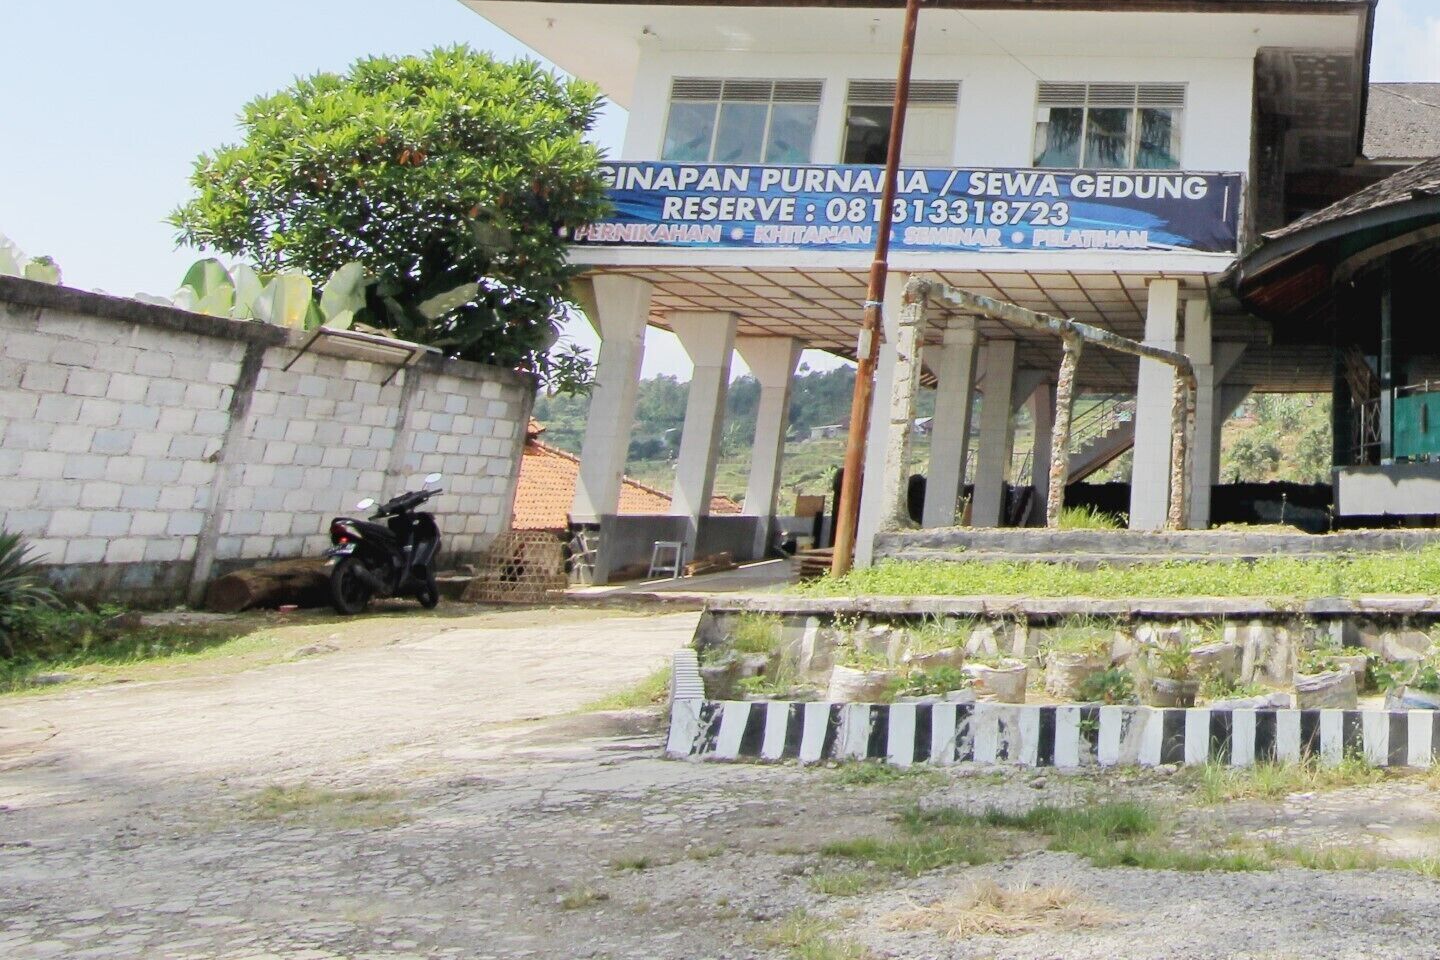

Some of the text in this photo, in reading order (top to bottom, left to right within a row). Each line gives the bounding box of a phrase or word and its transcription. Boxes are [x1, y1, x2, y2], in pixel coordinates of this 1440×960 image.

[968, 171, 1060, 197] SEWA
[1070, 174, 1208, 200] GEDUNG
[662, 196, 796, 222] RESERVE
[826, 197, 1069, 226] 081313318723
[574, 222, 1148, 248] PERNIKAHAN KHITANAN SEMINAR PELATIHAN
